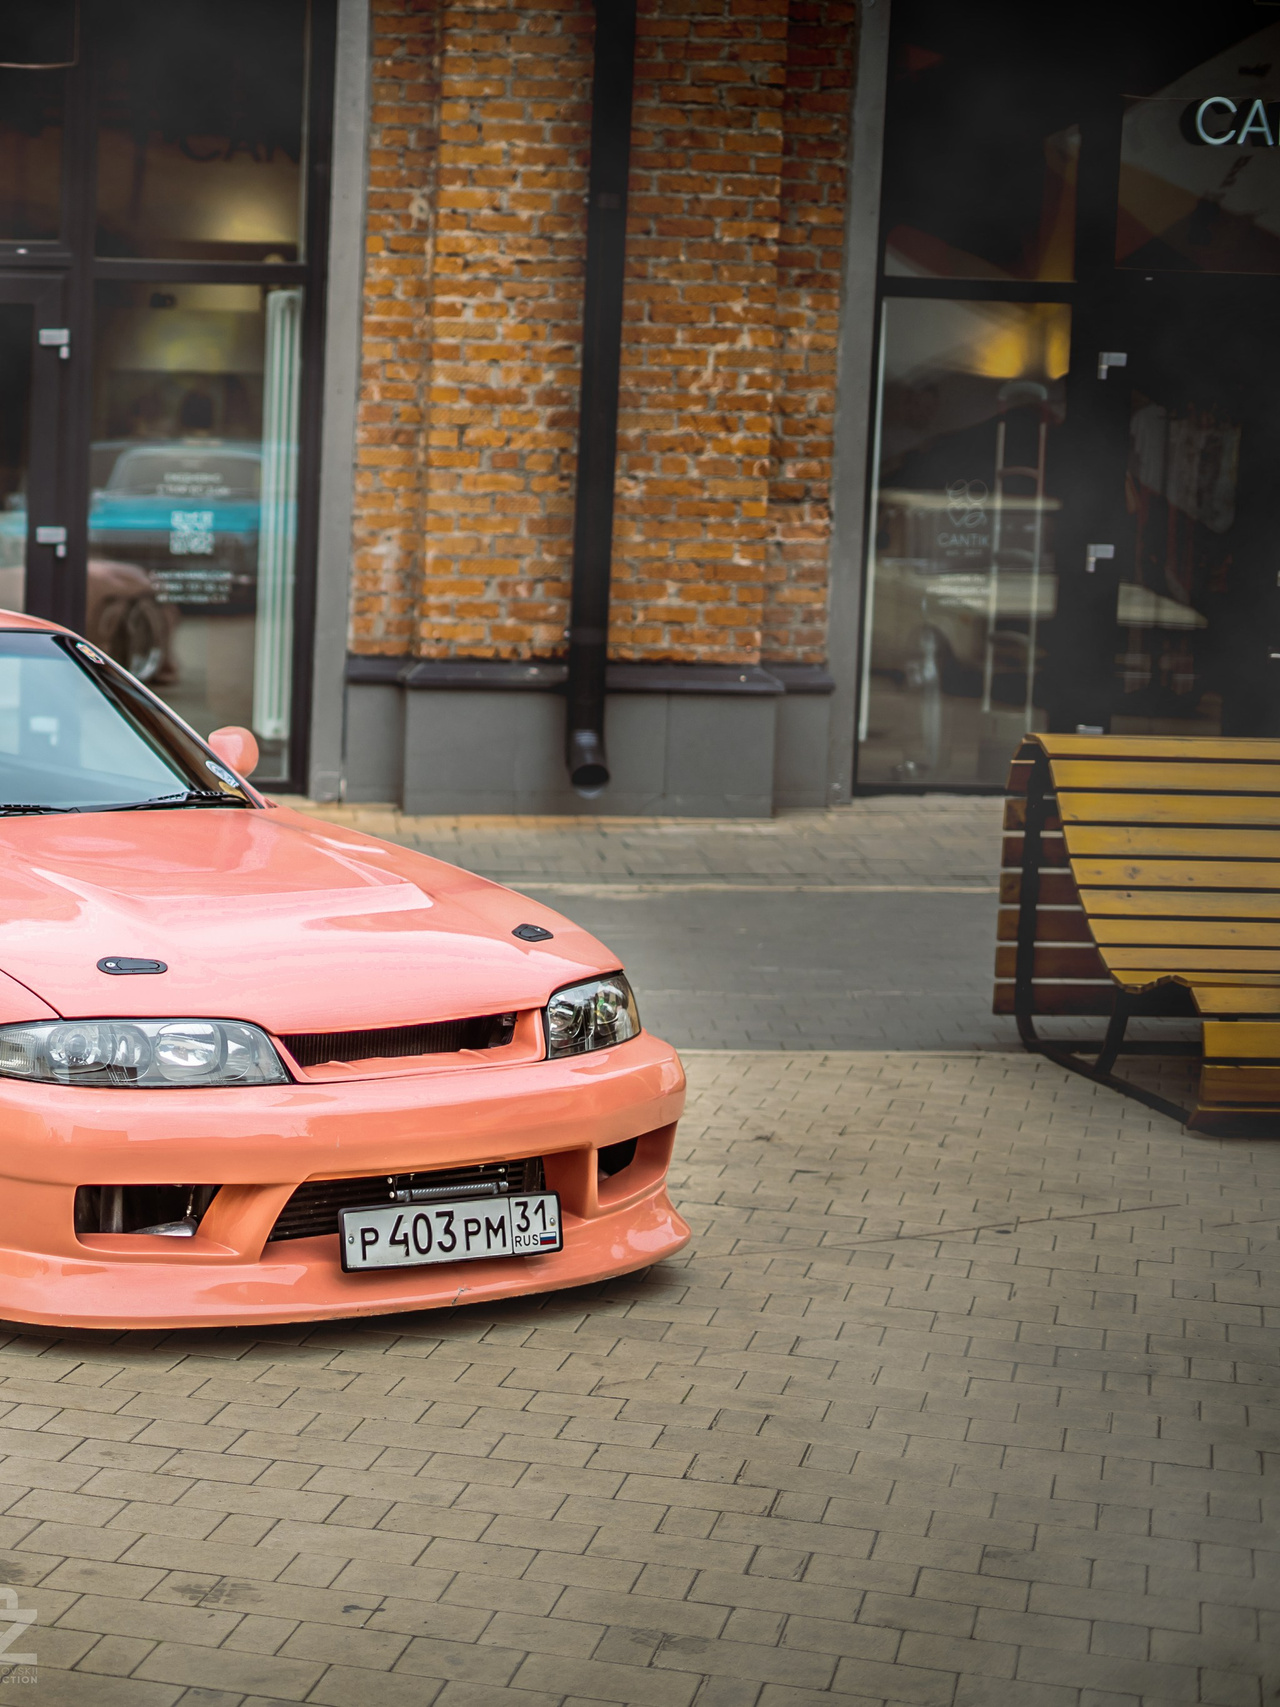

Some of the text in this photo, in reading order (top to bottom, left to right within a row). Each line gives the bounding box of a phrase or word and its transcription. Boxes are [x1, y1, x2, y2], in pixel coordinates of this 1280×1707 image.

[1195, 96, 1280, 146] CA
[937, 532, 990, 548] CANTIK
[515, 1199, 547, 1232] 31
[515, 1234, 539, 1247] RUS
